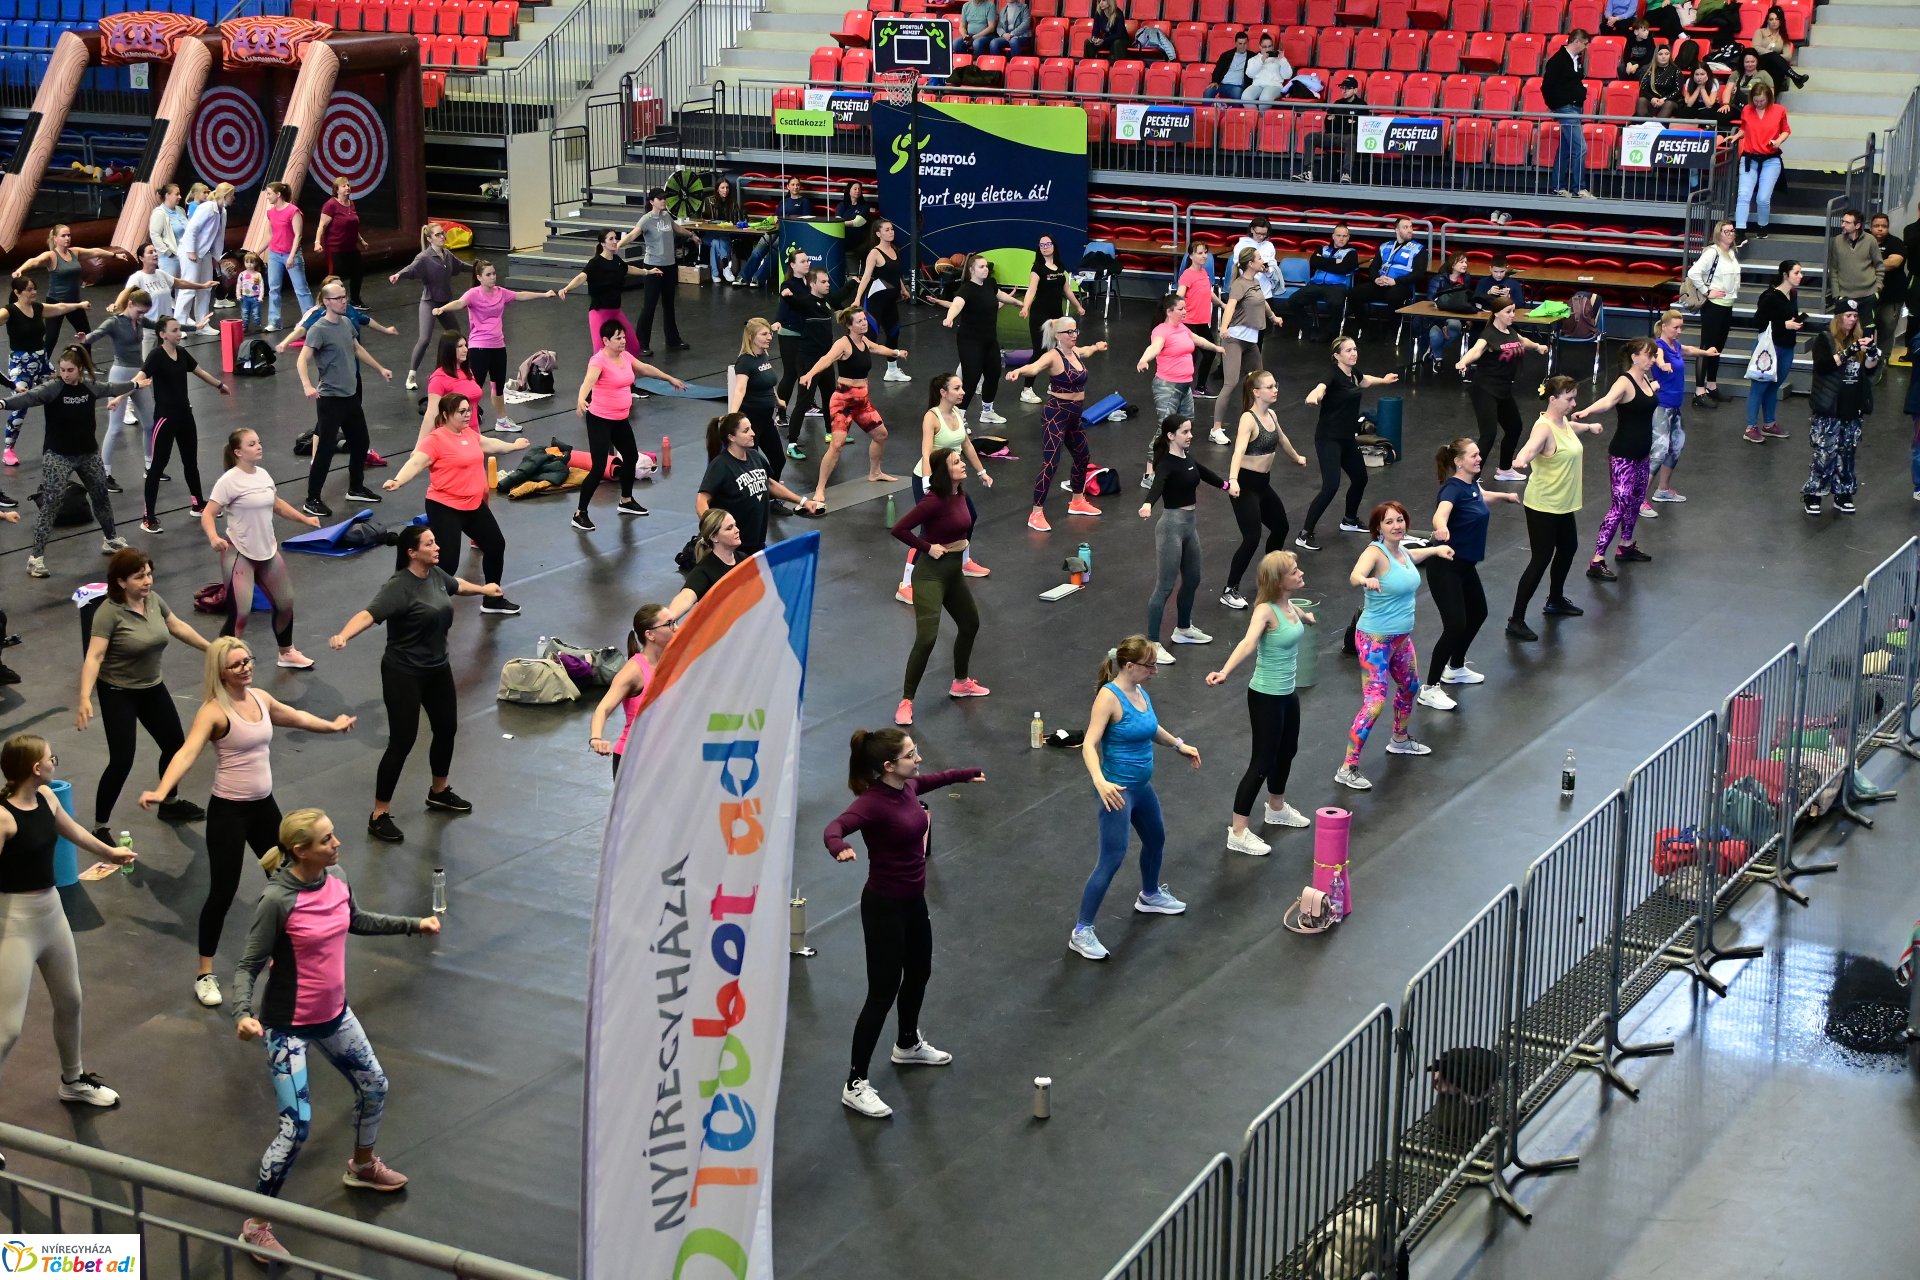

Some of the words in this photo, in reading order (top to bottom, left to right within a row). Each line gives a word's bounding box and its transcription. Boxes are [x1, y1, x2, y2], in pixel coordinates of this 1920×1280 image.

[110, 22, 166, 50] AXE
[233, 26, 291, 54] AXE
[119, 51, 162, 59] THROWING
[242, 56, 286, 64] THROWING
[831, 99, 869, 112] PECSÉTELŐ
[780, 117, 826, 127] Csatlakozz!
[1146, 115, 1190, 128] PECSÉTELŐ
[1390, 126, 1438, 140] PECSÉTELŐ
[1367, 139, 1375, 148] 13
[1658, 139, 1710, 153] PECSÉTELŐ
[919, 152, 976, 165] SPORTOLÓ
[1632, 152, 1641, 162] 14
[918, 166, 953, 177] EMZET
[918, 187, 950, 211] port
[954, 192, 976, 209] egy
[981, 184, 1023, 202] életen
[1028, 179, 1052, 200] át!
[747, 479, 768, 497] ROCK
[642, 852, 691, 1232] NYÍREGYHÁZA
